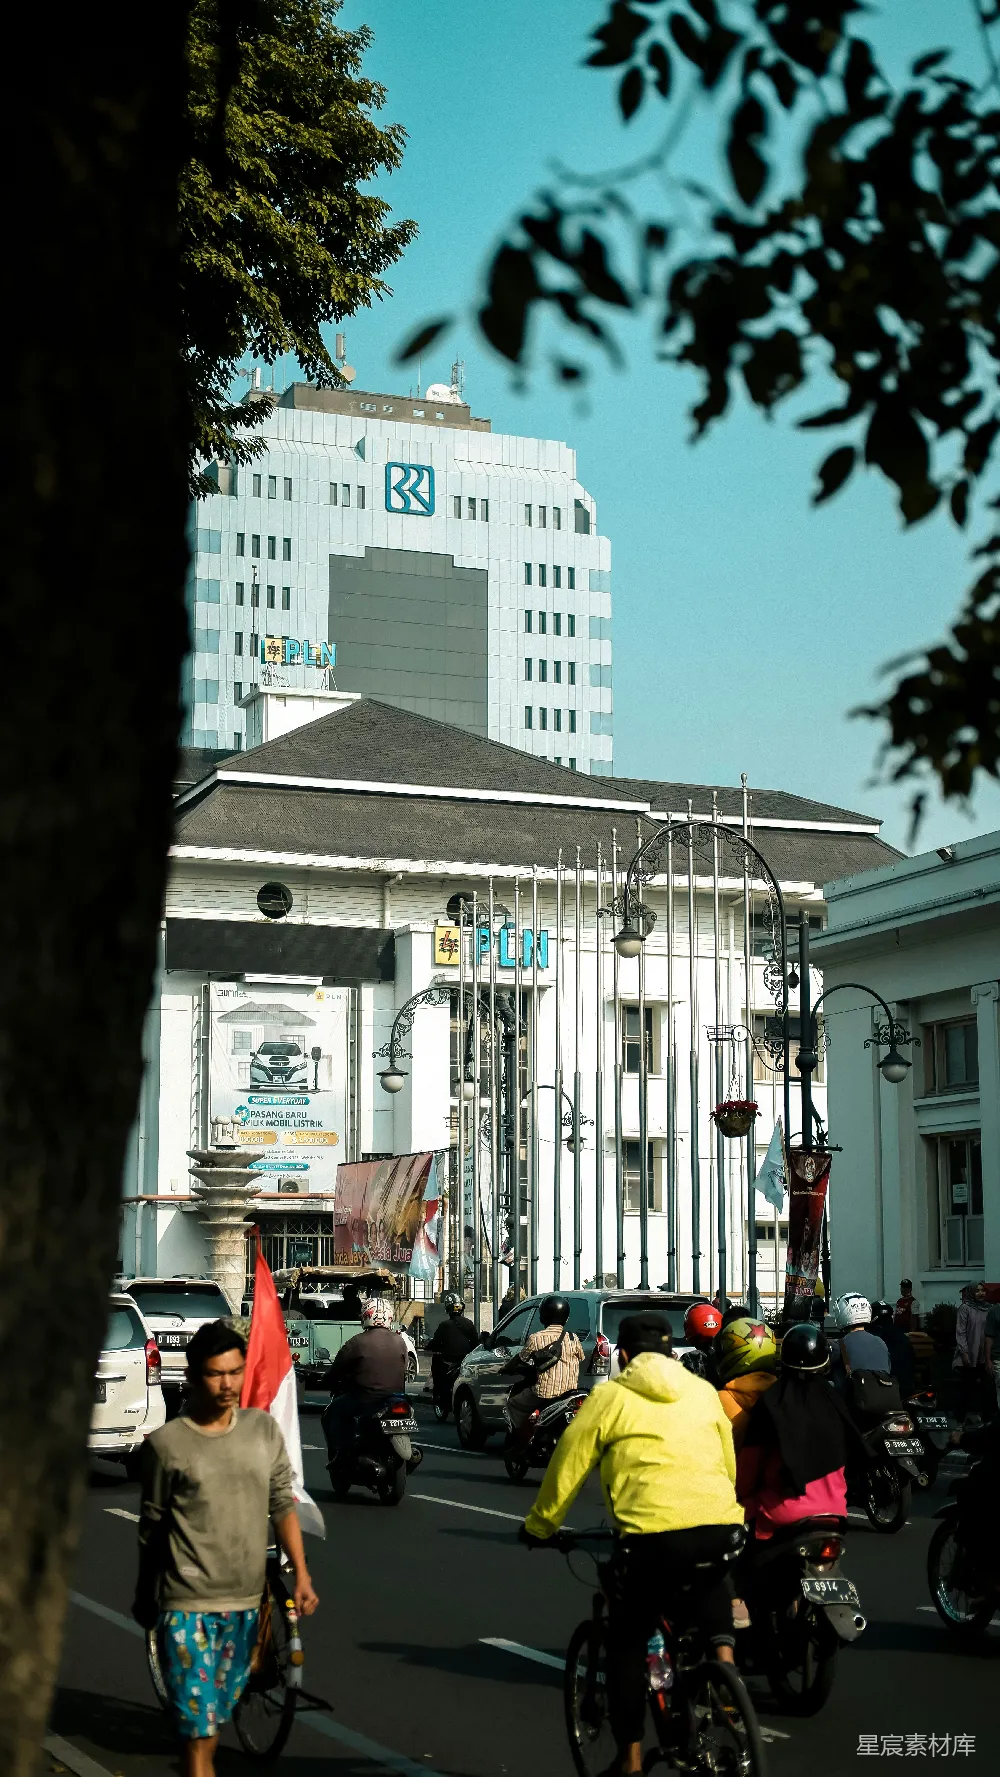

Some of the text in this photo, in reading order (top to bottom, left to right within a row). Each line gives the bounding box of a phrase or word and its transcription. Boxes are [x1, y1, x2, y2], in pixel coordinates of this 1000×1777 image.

[285, 639, 337, 666] PLN
[475, 928, 549, 968] PLN
[326, 993, 342, 1001] PLN
[250, 1110, 307, 1119] PASANG BARU
[265, 1119, 292, 1128] MOBIL
[293, 1119, 324, 1128] LISTRIK
